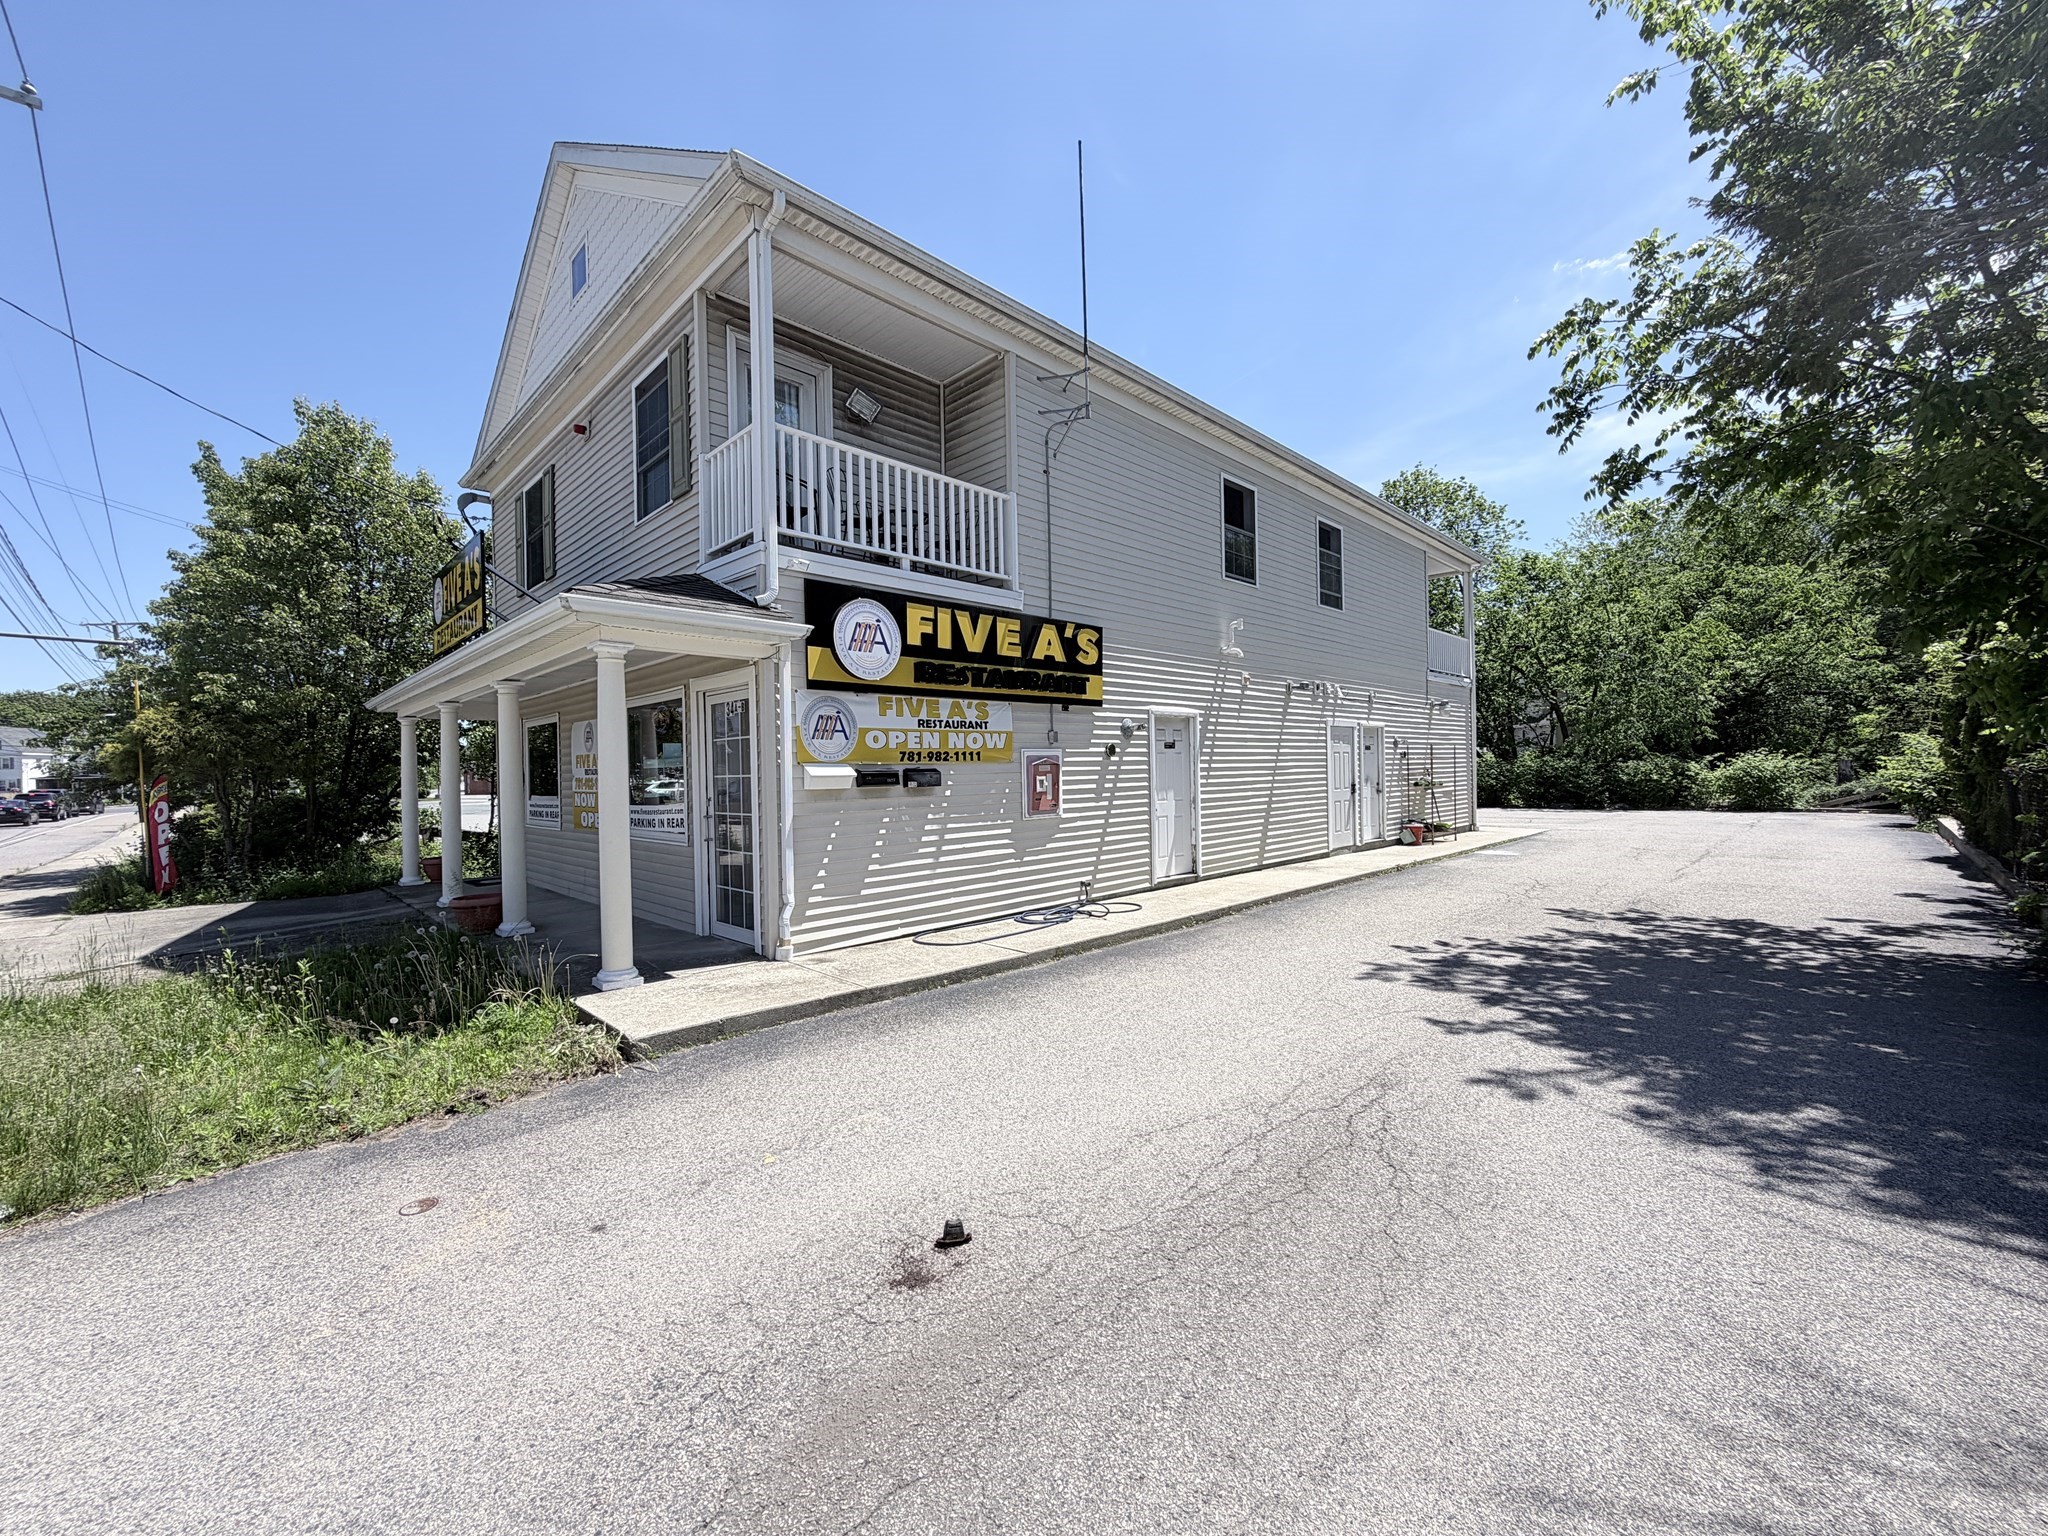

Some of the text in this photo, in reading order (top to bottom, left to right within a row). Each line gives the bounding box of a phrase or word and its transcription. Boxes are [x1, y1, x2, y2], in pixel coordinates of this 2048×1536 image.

[443, 562, 462, 614] FIVE
[464, 546, 480, 599] A'S
[436, 604, 479, 652] RESTAURANT
[906, 601, 1022, 658] FIVE
[1032, 622, 1100, 666] A'S
[913, 660, 1090, 695] RESTAURANT
[878, 696, 941, 719] FIVE
[947, 700, 990, 721] A'S
[917, 719, 990, 730] RESTAURANT
[865, 730, 1008, 750] OPEN NOW
[575, 753, 598, 769] FIVE A
[899, 751, 981, 762] 781-982-1111
[574, 792, 596, 808] NOW
[580, 811, 599, 828] OPE
[630, 817, 685, 829] PARKING IN REAR
[154, 801, 170, 891] OPEN
